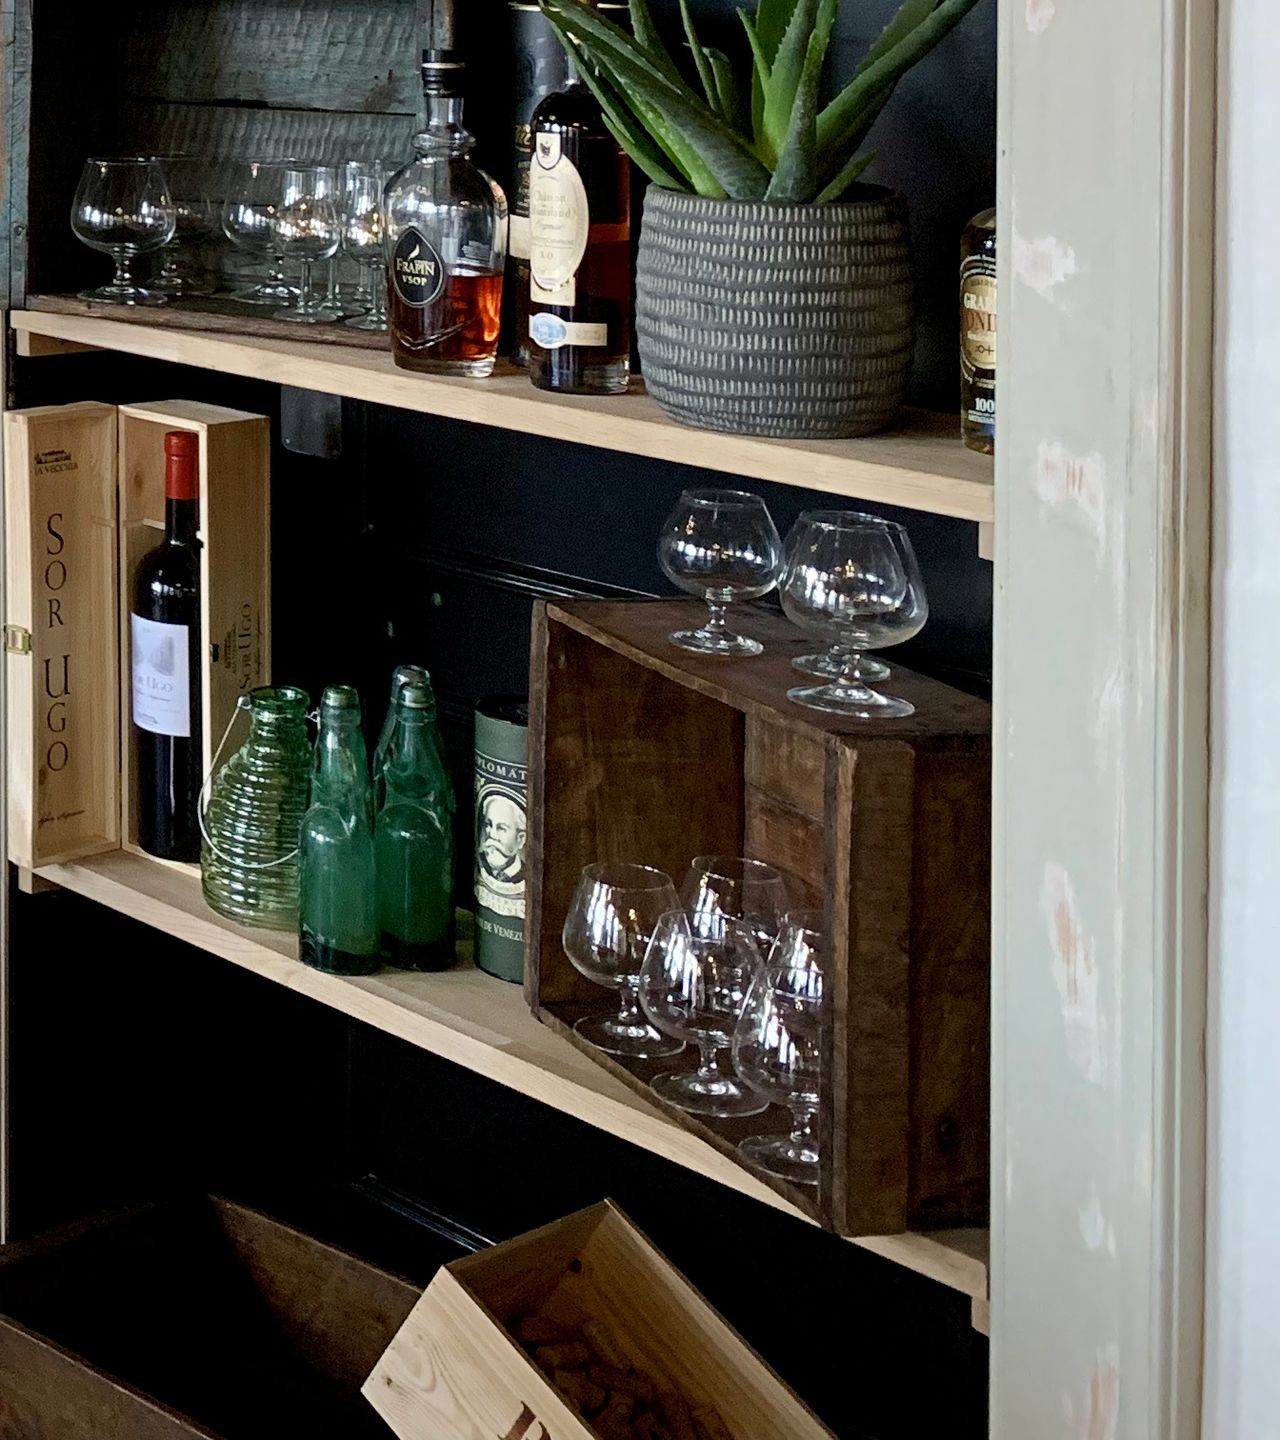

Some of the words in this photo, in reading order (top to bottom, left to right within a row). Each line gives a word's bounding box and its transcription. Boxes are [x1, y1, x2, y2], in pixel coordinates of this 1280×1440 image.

[396, 257, 435, 276] FRAPIN
[43, 512, 68, 629] SOR
[43, 654, 71, 773] UGO
